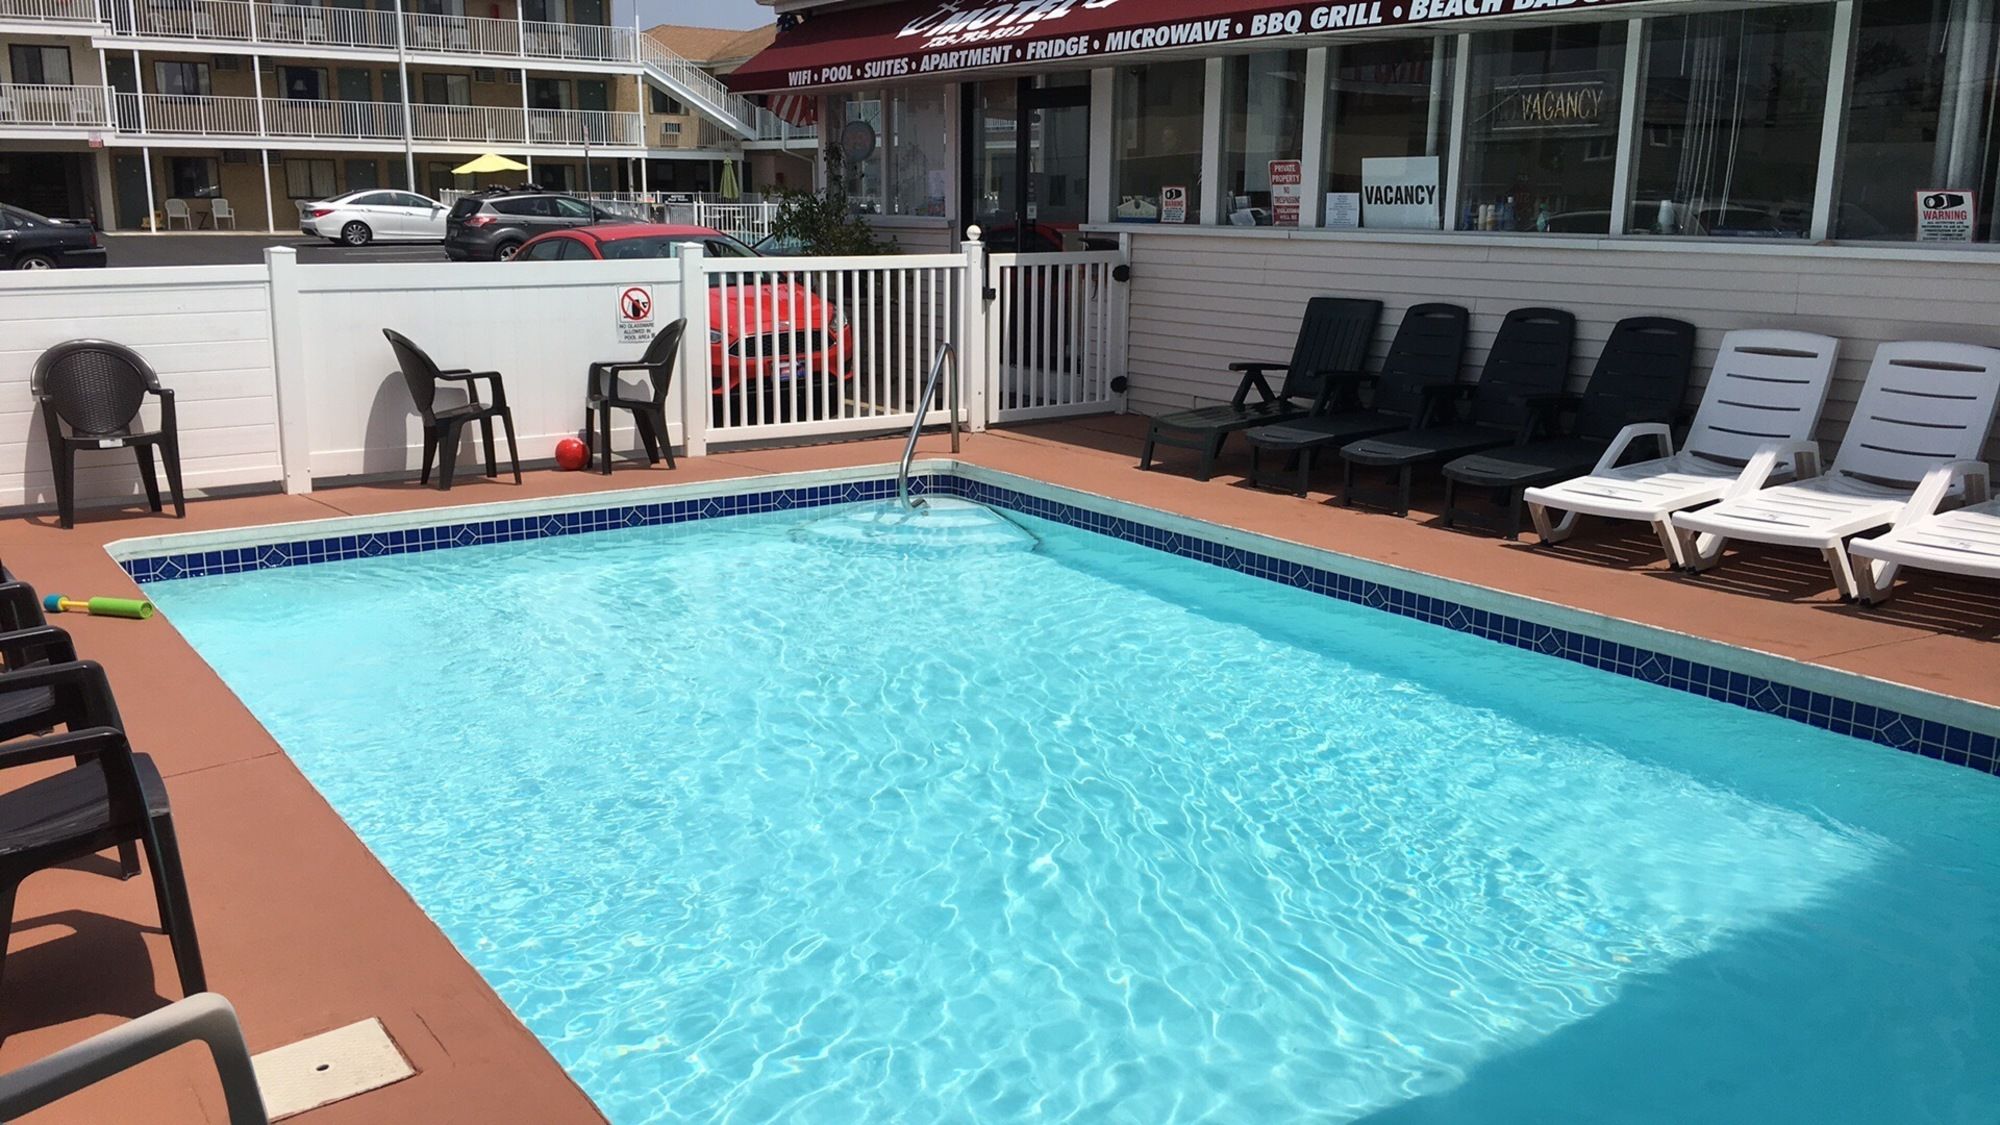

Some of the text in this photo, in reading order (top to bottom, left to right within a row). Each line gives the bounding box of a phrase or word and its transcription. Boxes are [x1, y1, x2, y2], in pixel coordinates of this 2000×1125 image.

[923, 0, 1076, 37] MOTEL
[788, 0, 1503, 87] WIFI POOL SUITES APARTMENT FRIDGE MICROWAVE BBQ GRILL BEACH
[1522, 88, 1603, 120] VACANCY
[1272, 174, 1300, 183] PROPERTY
[1364, 185, 1436, 205] VACANCY
[1923, 210, 1968, 220] WARNING
